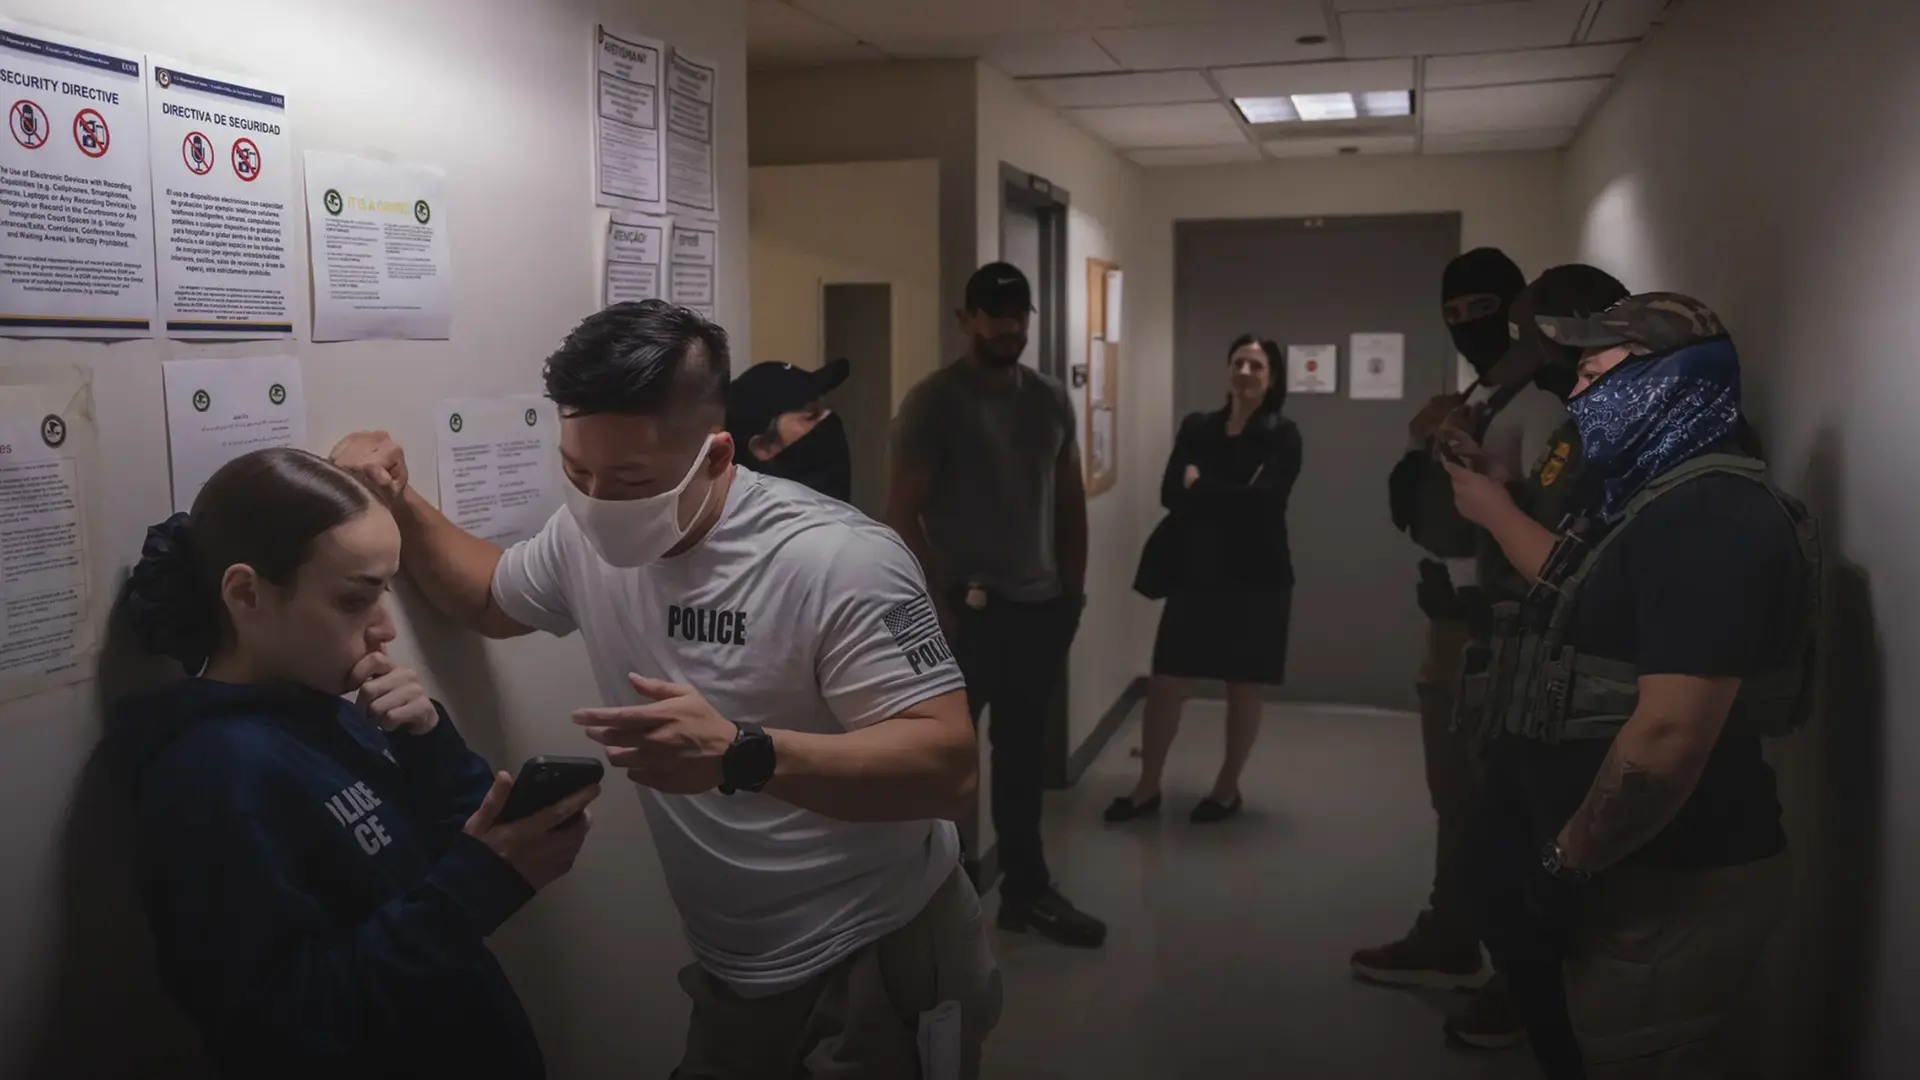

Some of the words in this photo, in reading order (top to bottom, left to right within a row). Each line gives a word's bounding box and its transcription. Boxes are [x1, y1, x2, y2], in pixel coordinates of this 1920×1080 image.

[0, 69, 58, 92] SECURITY
[62, 82, 119, 105] DIRECTIVE
[162, 102, 212, 123] DIRECTIVA
[214, 113, 226, 125] DE
[229, 116, 280, 135] SEGURIDAD
[30, 170, 62, 181] Electronic
[64, 174, 88, 184] Devices
[103, 179, 132, 192] Recording
[23, 190, 49, 200] Laptops
[60, 194, 72, 204] Any
[74, 196, 104, 207] Recording
[39, 203, 63, 212] Record
[83, 207, 117, 217] Courtrooms
[126, 212, 137, 221] Any
[47, 213, 65, 222] Court
[67, 215, 89, 224] Spaces
[81, 227, 115, 236] Conference
[668, 605, 747, 646] POLICE
